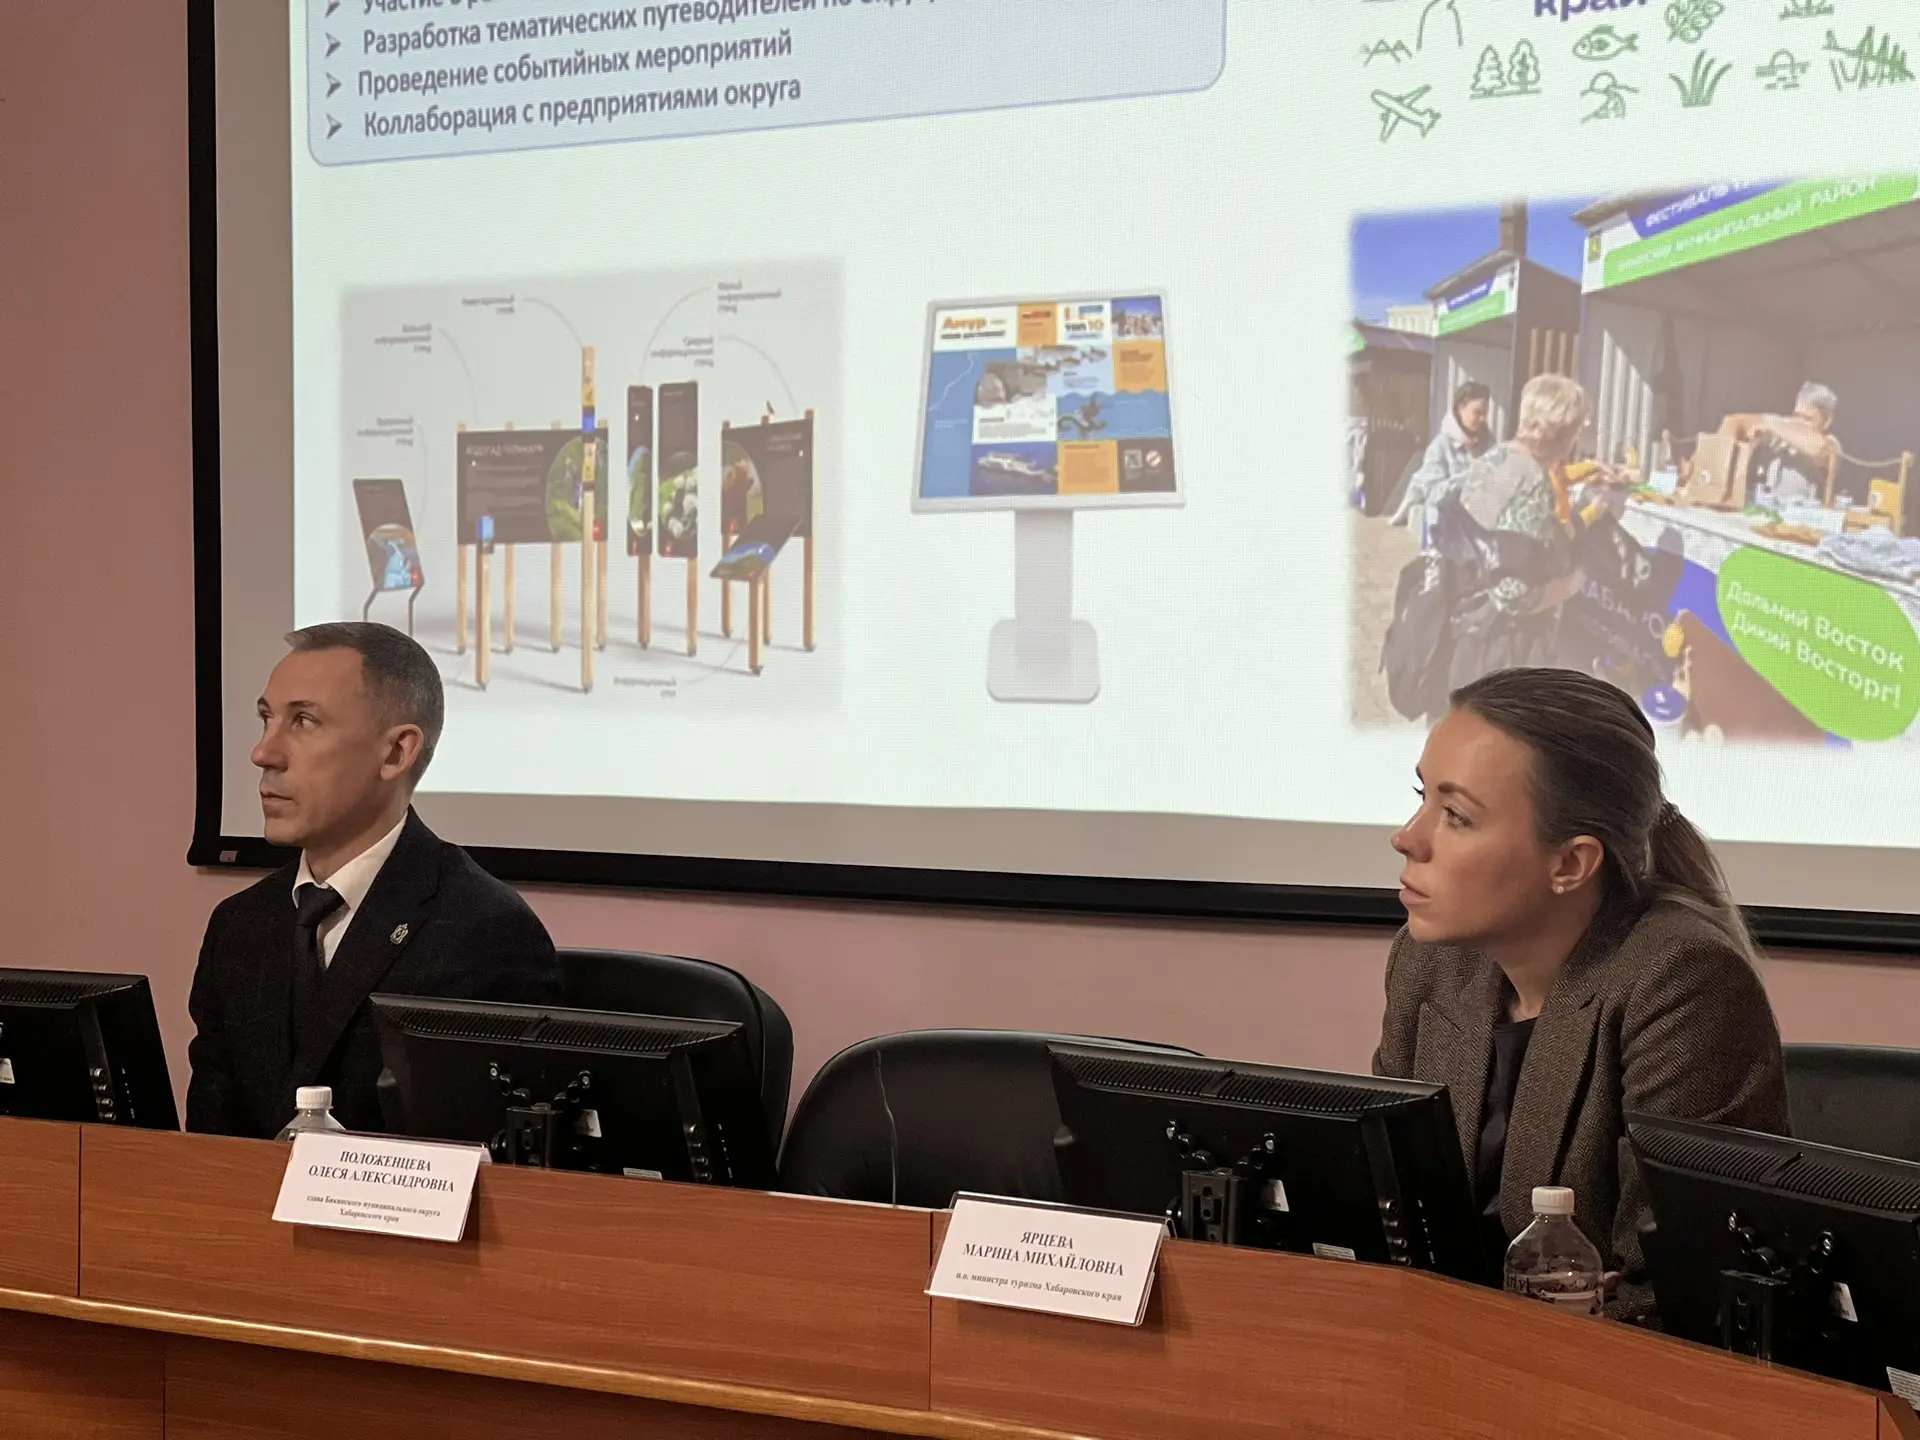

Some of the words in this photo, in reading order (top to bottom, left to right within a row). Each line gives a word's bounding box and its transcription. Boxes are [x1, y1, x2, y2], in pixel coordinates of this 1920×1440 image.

[363, 22, 481, 57] Разработка
[486, 7, 638, 43] тематических
[358, 65, 488, 100] Проведение
[494, 50, 631, 84] событийных
[636, 28, 792, 72] мероприятий
[364, 104, 517, 137] Коллаборация
[523, 103, 534, 123] с
[540, 87, 718, 126] предприятиями
[724, 78, 801, 108] округа
[1727, 581, 1809, 630] Дальний
[1732, 612, 1790, 655] Дикий
[340, 1150, 432, 1172] ПОЛОЖЕНЦЕВА
[308, 1164, 348, 1179] ОЛЕСЯ
[349, 1171, 454, 1192] АЛЕКСАНДРОВНА
[339, 1208, 382, 1221] Хабаровского
[383, 1215, 400, 1223] края
[418, 1208, 441, 1217] округа
[1020, 1231, 1074, 1250] ЯРЦЕВА
[962, 1244, 1019, 1262] МАРИНА
[1022, 1250, 1124, 1276] МИХАЙЛОВНА
[971, 1275, 1009, 1286] министра
[1010, 1279, 1042, 1290] туризма
[1044, 1282, 1100, 1297] Хабаровского
[1102, 1291, 1122, 1301] края
